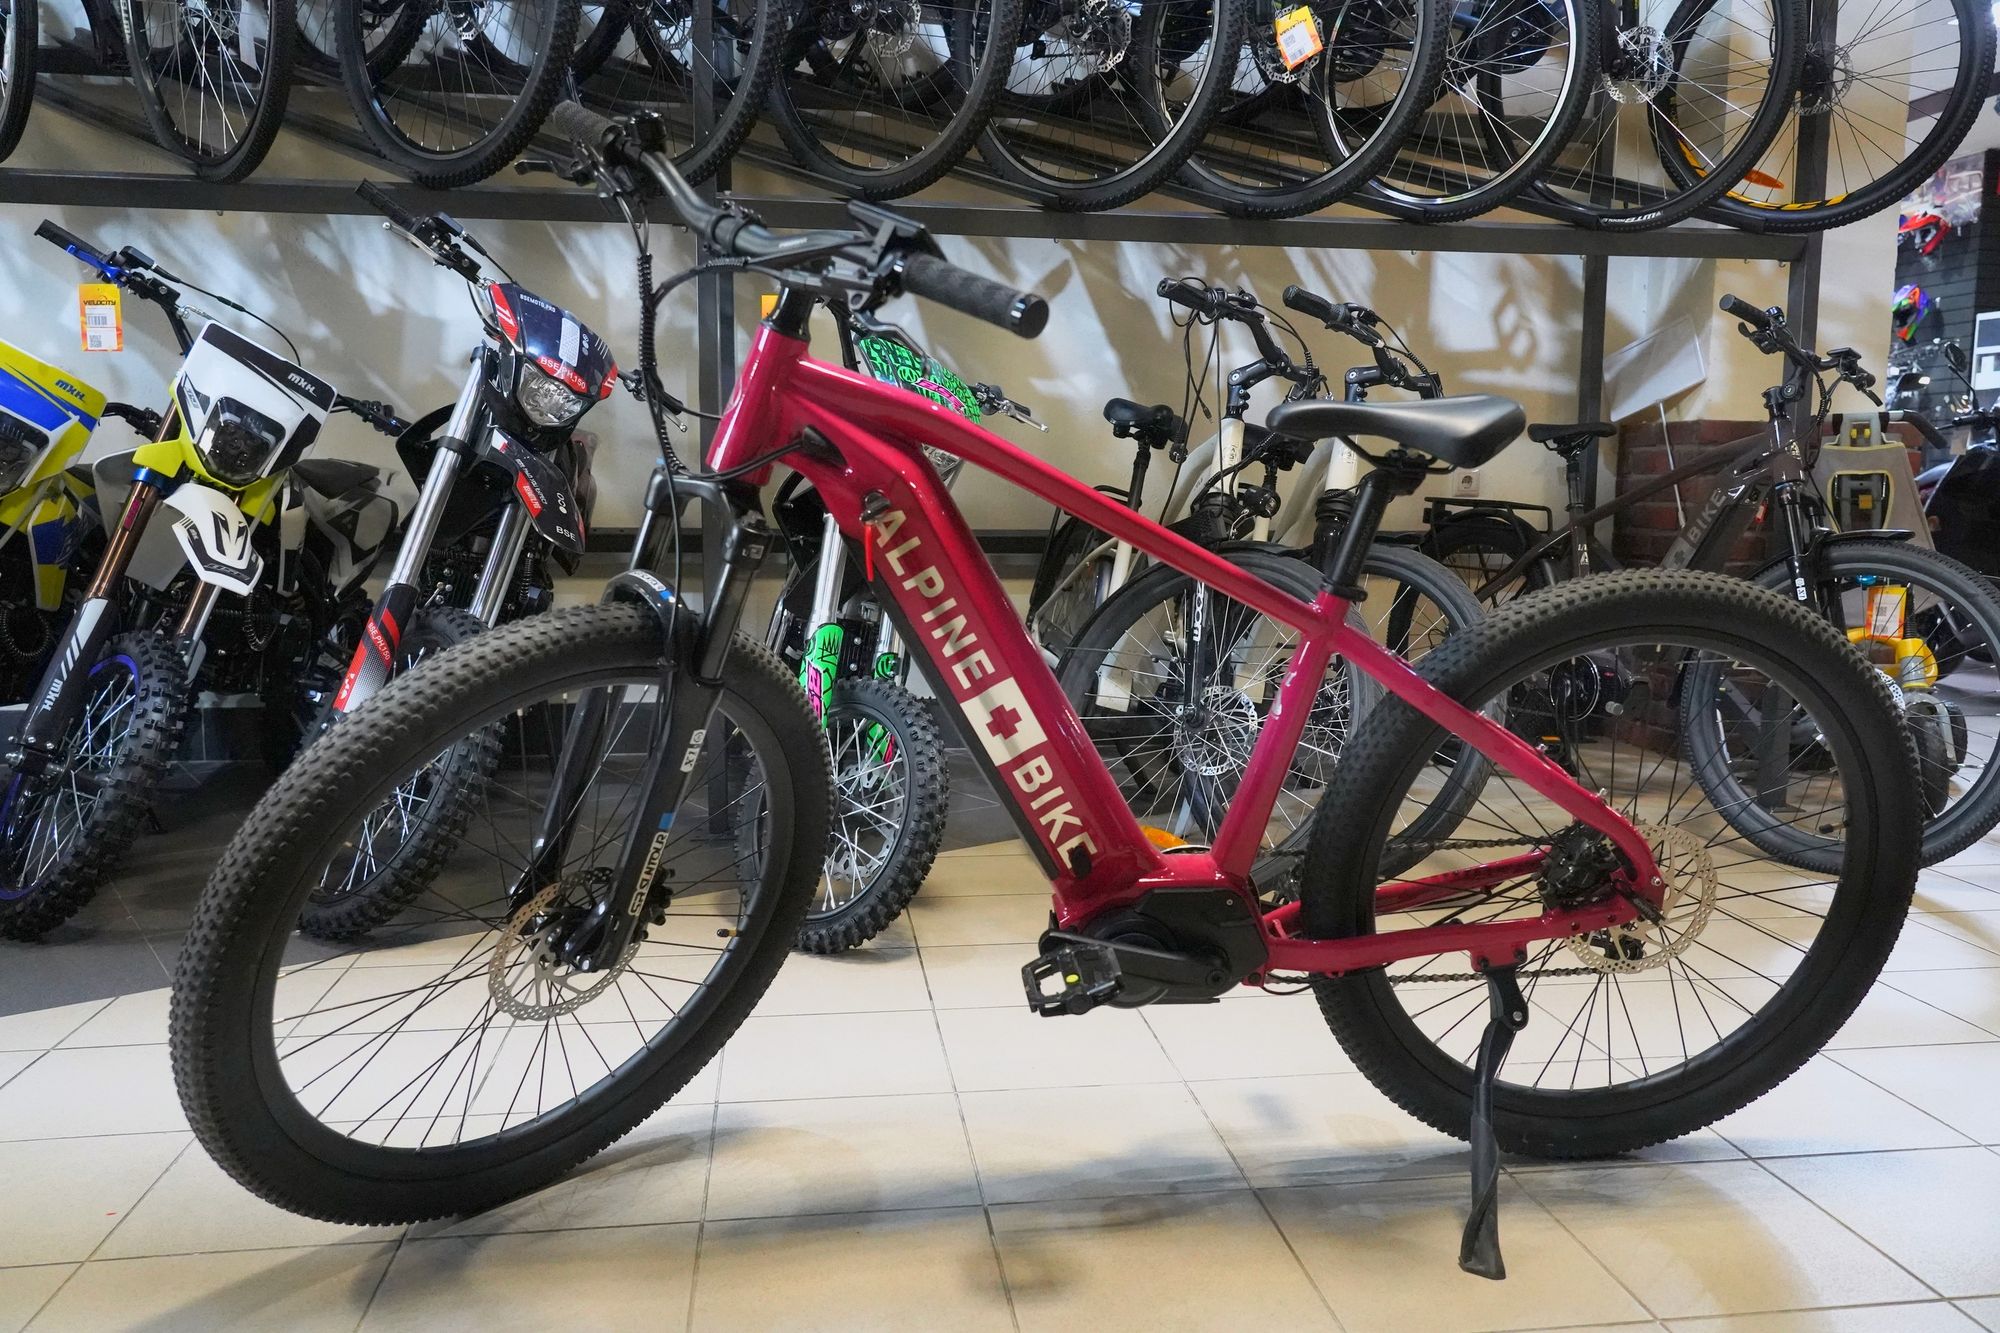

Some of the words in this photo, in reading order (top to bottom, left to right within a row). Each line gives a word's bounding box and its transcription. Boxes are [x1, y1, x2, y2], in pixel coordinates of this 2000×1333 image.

[555, 525, 577, 541] BSE
[1687, 487, 1727, 543] BIKE
[873, 509, 996, 691] ALPINE
[1012, 754, 1098, 870] BIKE
[637, 832, 668, 891] SUNTOUR
